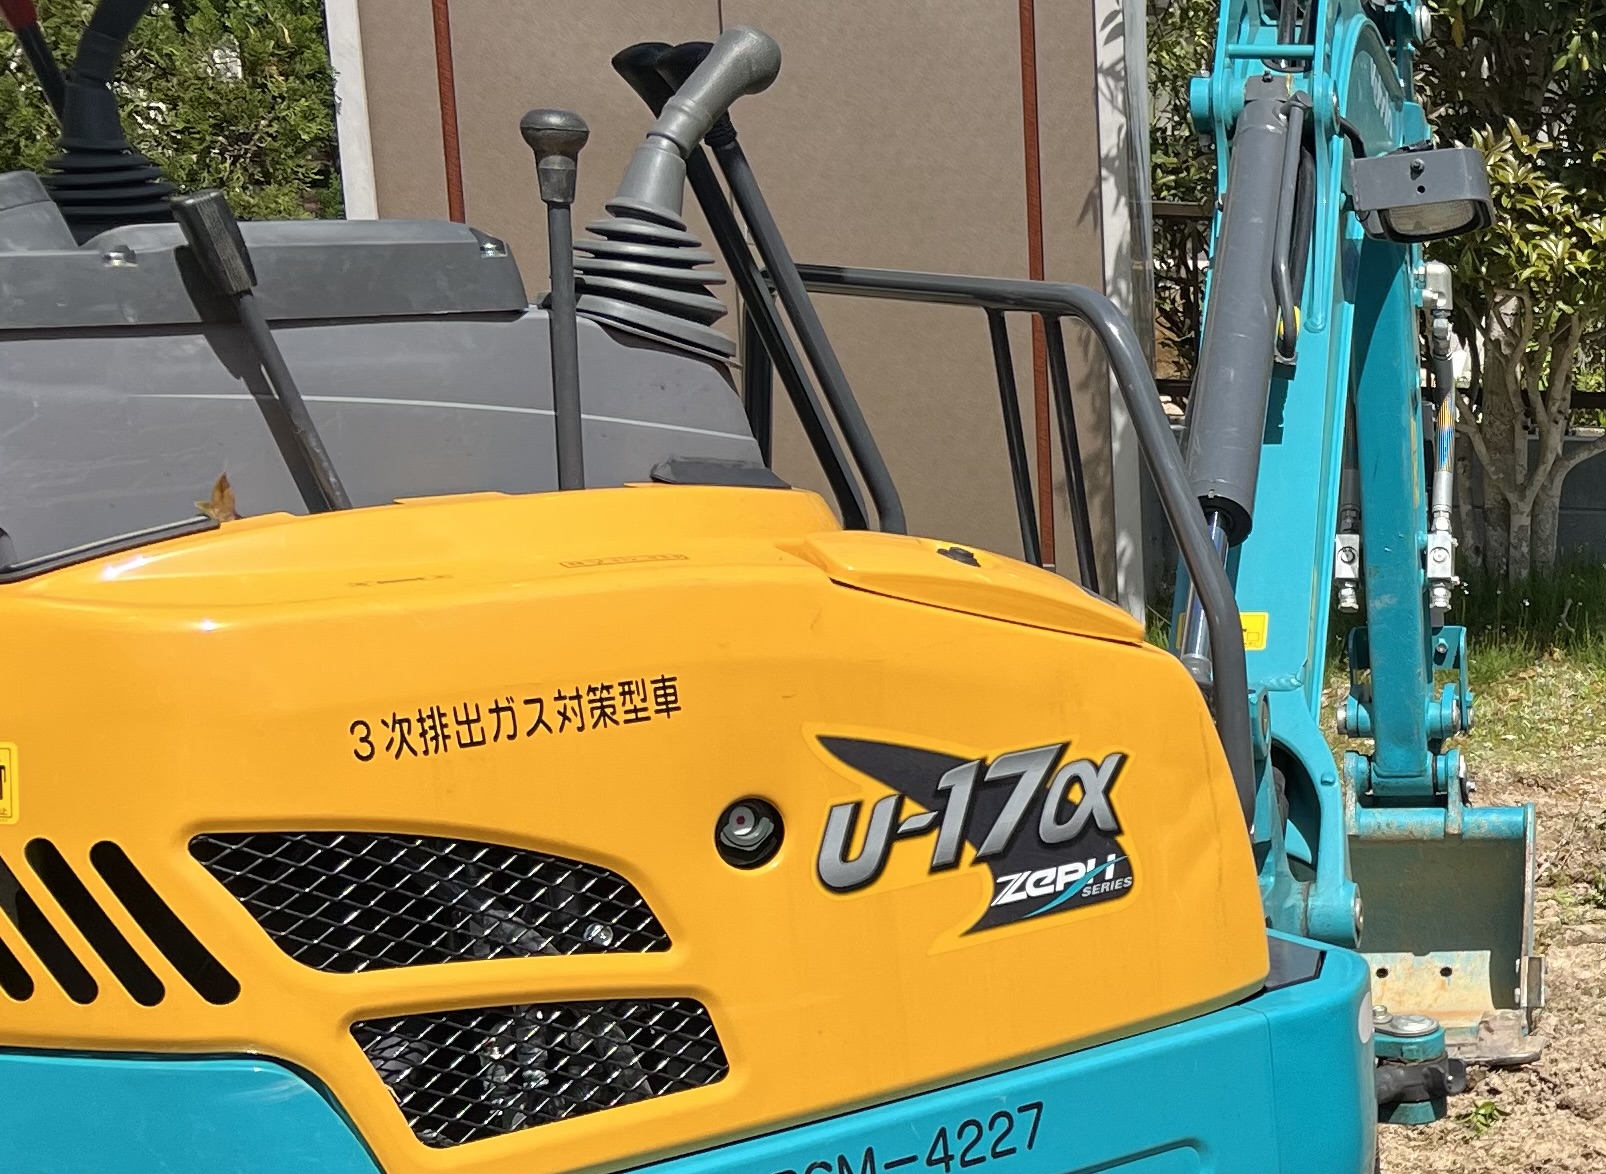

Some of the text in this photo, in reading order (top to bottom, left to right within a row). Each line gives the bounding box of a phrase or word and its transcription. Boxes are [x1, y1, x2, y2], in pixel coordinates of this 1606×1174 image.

[349, 674, 682, 762] 3次排出ガス対策型車
[1081, 876, 1133, 898] SERIES
